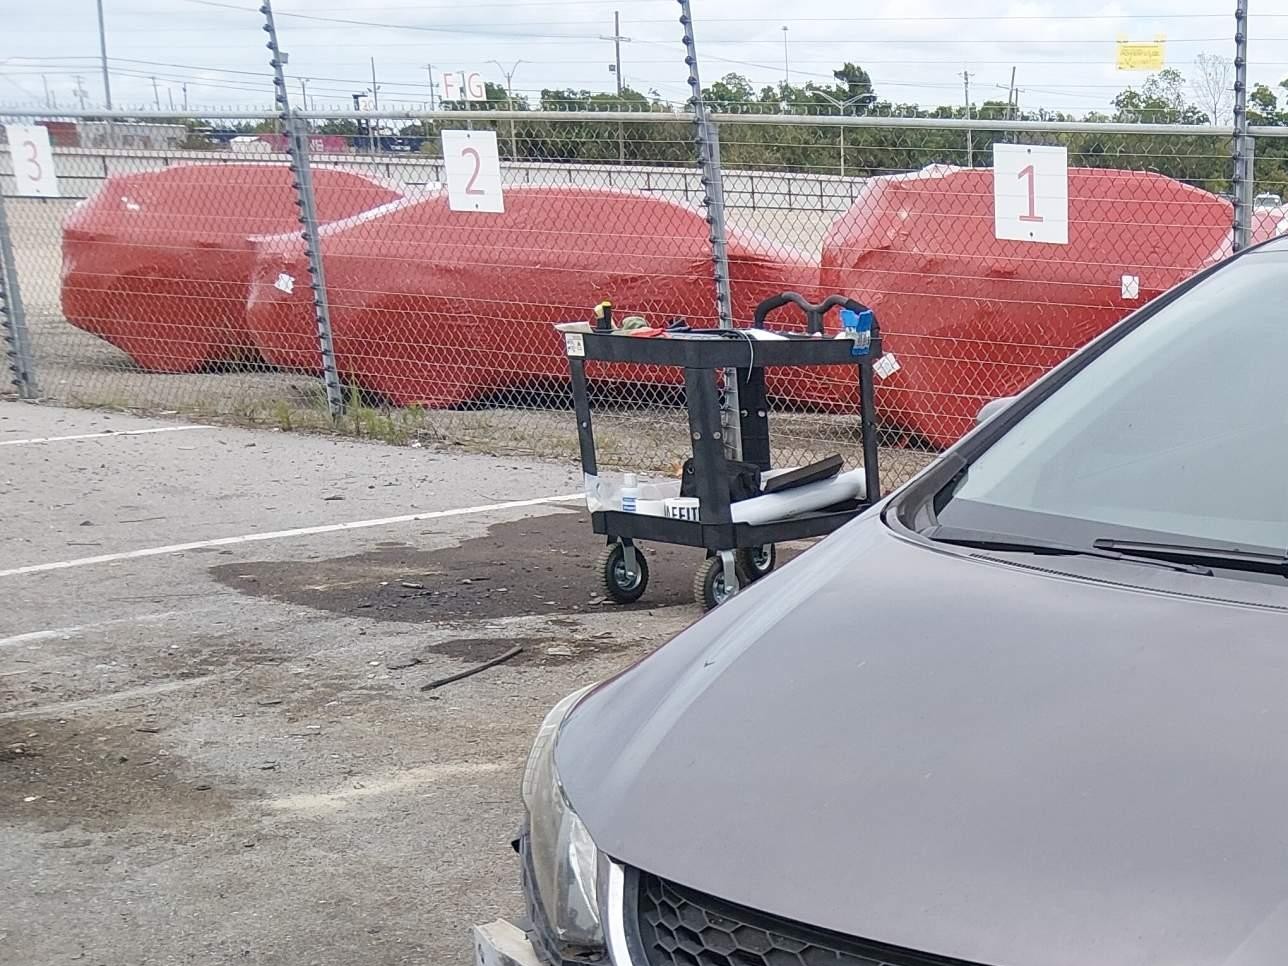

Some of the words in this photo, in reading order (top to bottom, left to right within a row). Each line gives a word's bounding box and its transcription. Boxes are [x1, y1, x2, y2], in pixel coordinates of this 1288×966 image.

[443, 72, 455, 99] F
[468, 72, 483, 98] G
[23, 140, 42, 181] 3
[461, 147, 485, 195] 2
[1017, 164, 1044, 223] 1
